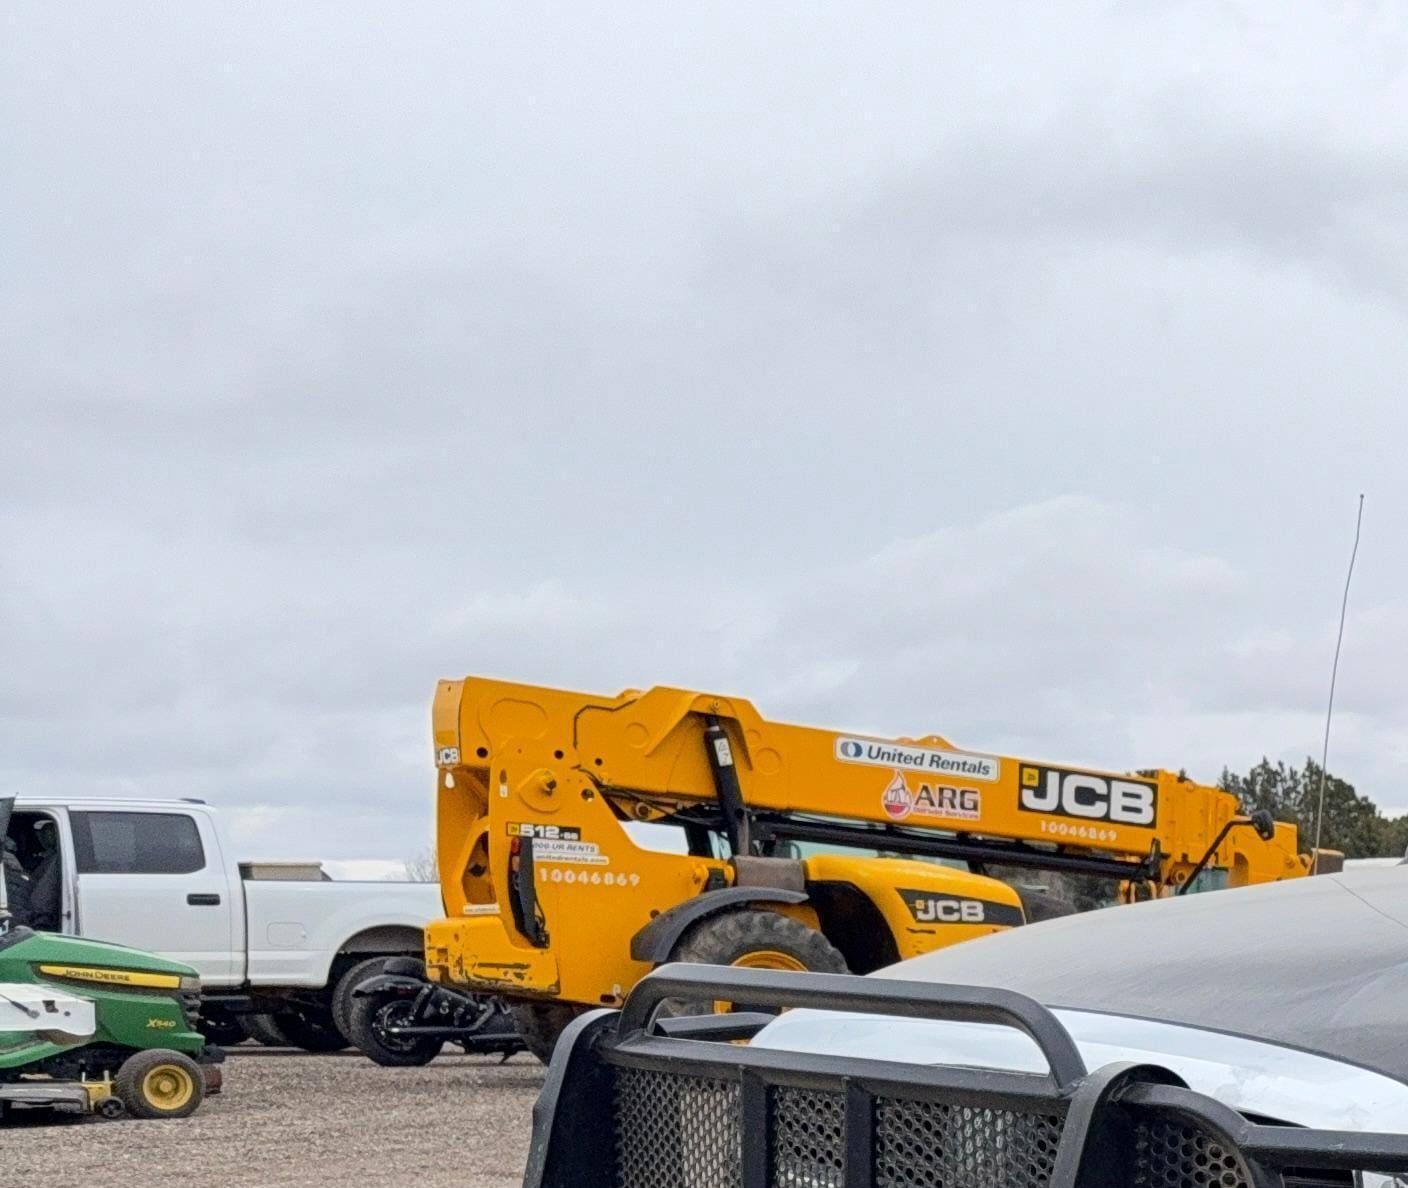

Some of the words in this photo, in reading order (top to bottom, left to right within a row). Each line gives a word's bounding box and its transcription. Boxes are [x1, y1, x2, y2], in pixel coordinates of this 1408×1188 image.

[867, 745, 924, 767] United
[929, 754, 991, 776] Rentals
[914, 784, 979, 812] ARG
[1022, 770, 1155, 825] JCB
[1040, 820, 1117, 841] 10046869
[539, 868, 641, 888] 10046869
[916, 899, 985, 922] JCB
[65, 969, 93, 980] JOHN
[94, 972, 131, 982] DEERE
